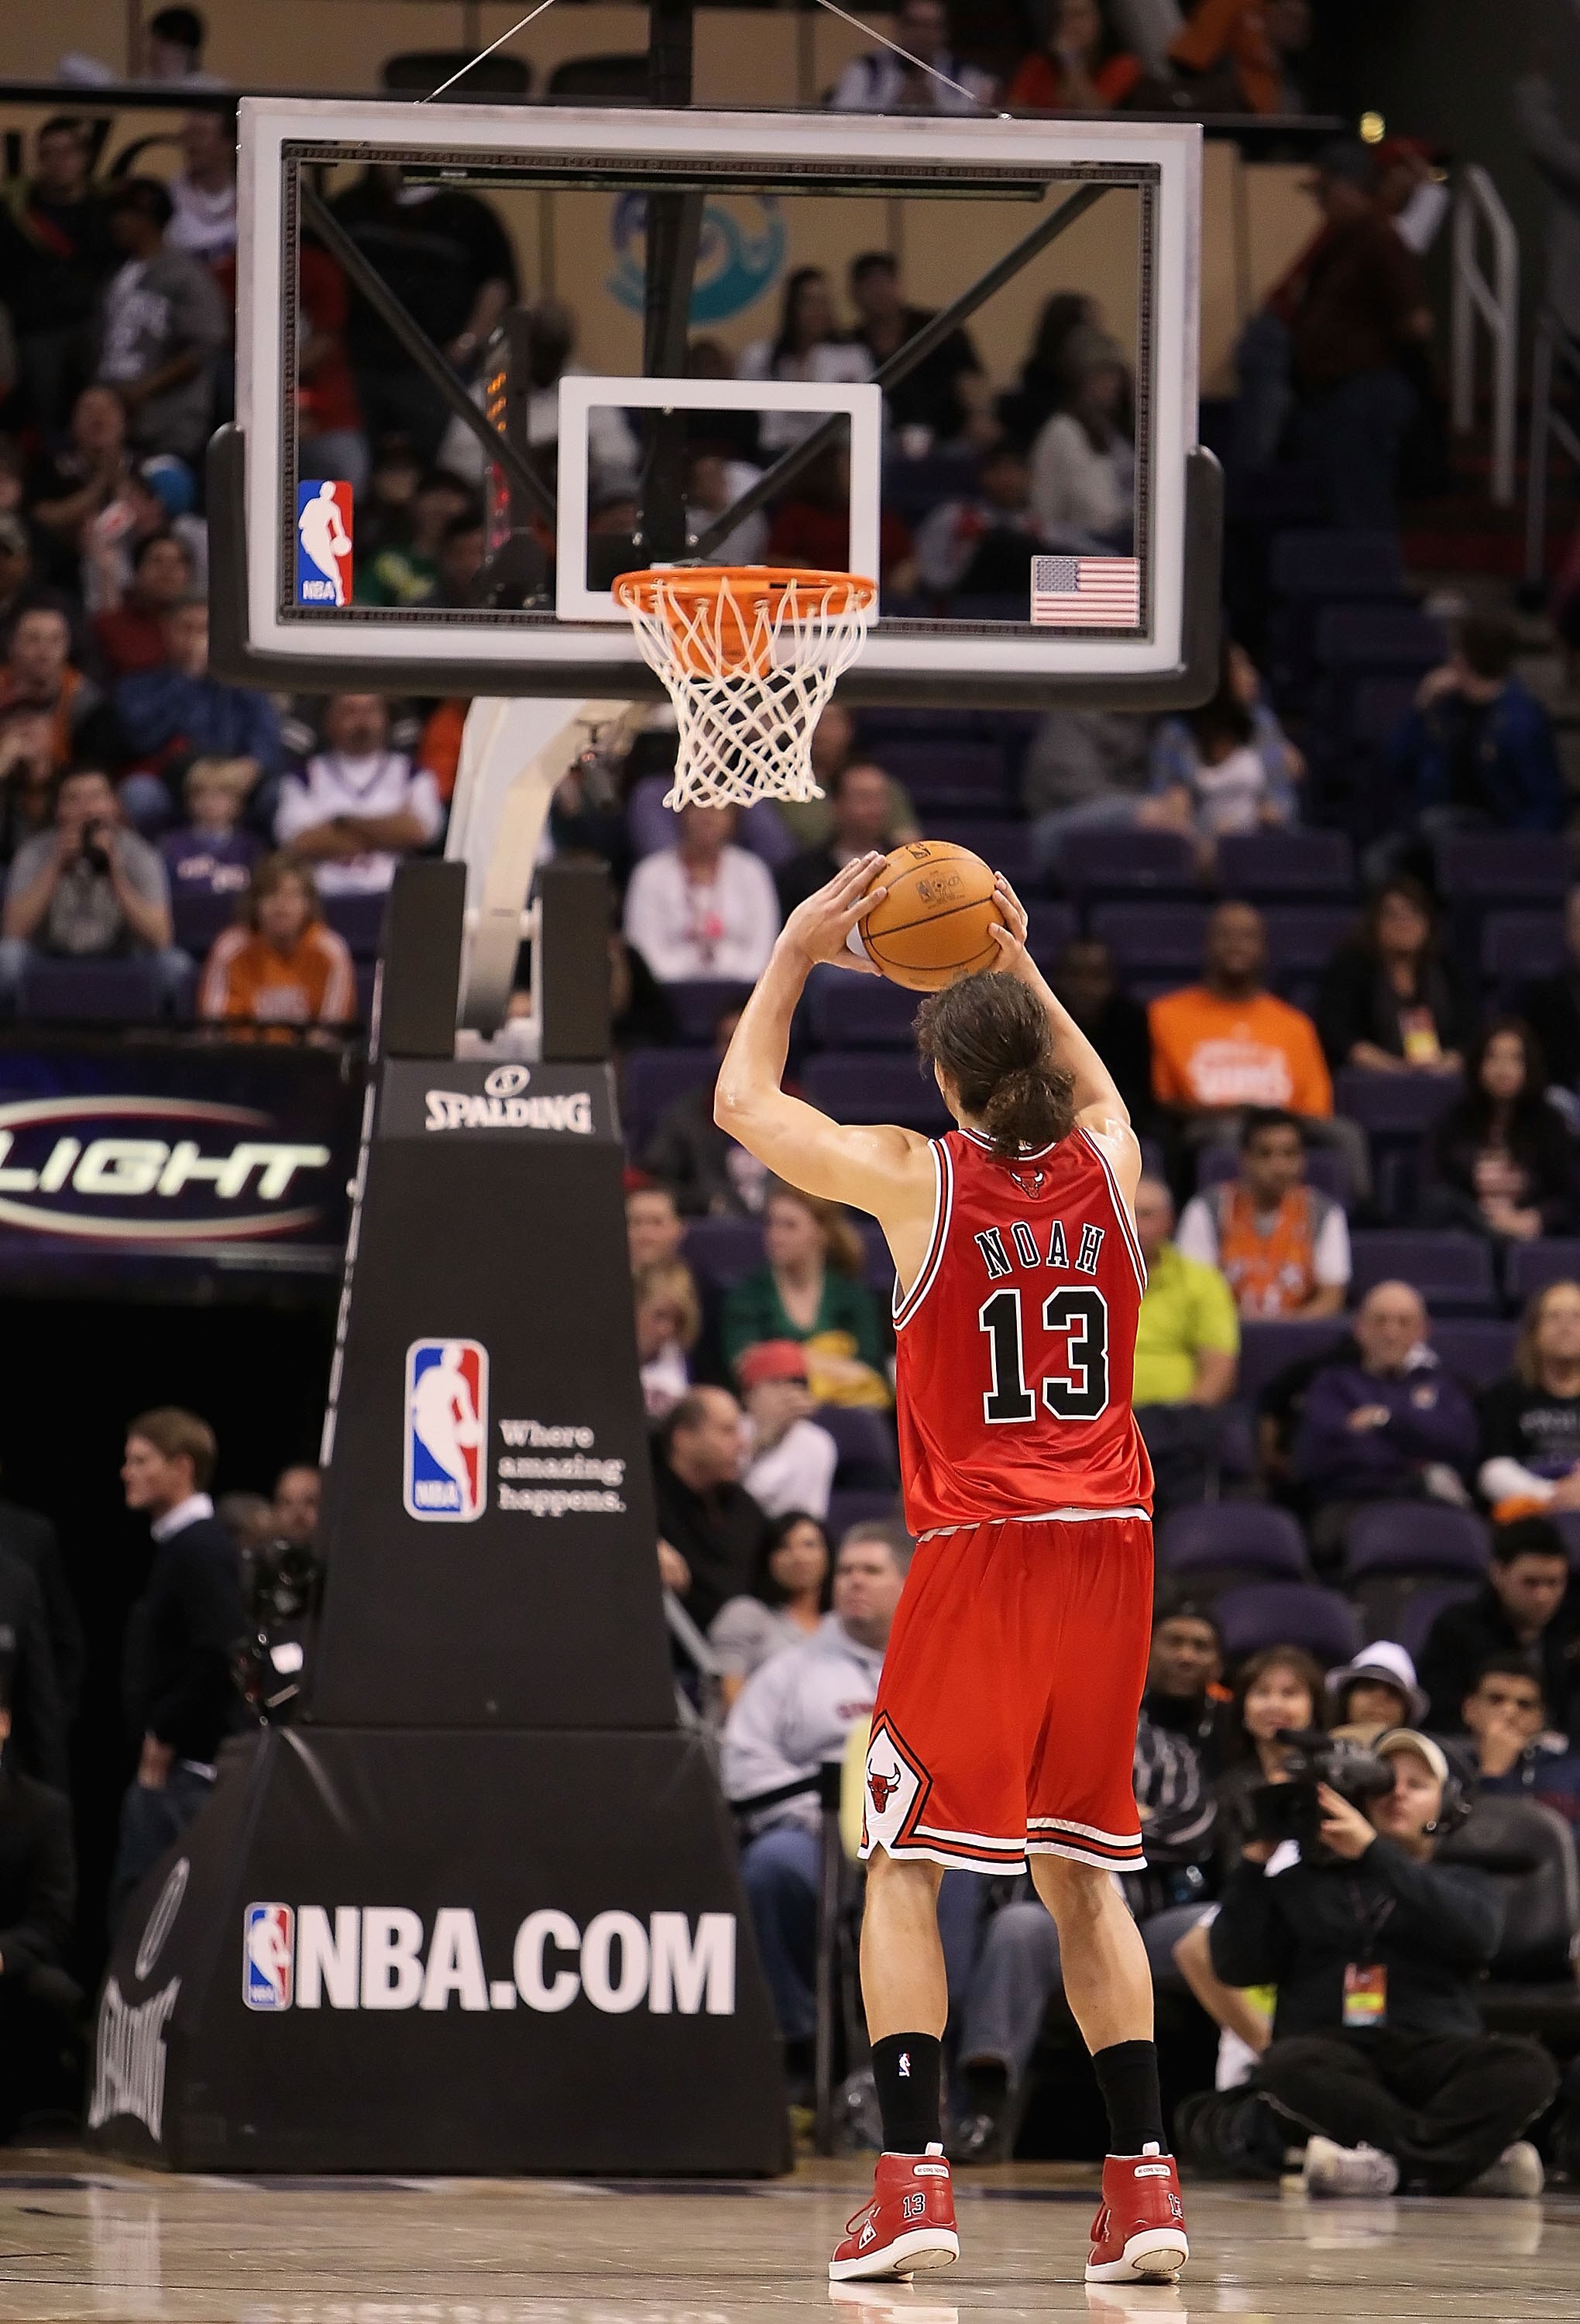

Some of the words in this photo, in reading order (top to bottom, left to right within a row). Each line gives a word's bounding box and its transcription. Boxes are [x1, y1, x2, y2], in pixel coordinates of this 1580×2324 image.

[303, 580, 335, 600] NBA
[425, 1089, 596, 1135] SPALDING
[0, 1129, 331, 1200] LIGHT
[974, 1219, 1105, 1280] NOAH
[978, 1286, 1109, 1424] 13
[498, 1419, 594, 1449] Where
[498, 1452, 626, 1487] amazing
[497, 1483, 627, 1517] happens.
[296, 1905, 736, 2014] NBA.COM
[902, 2192, 926, 2219] 13
